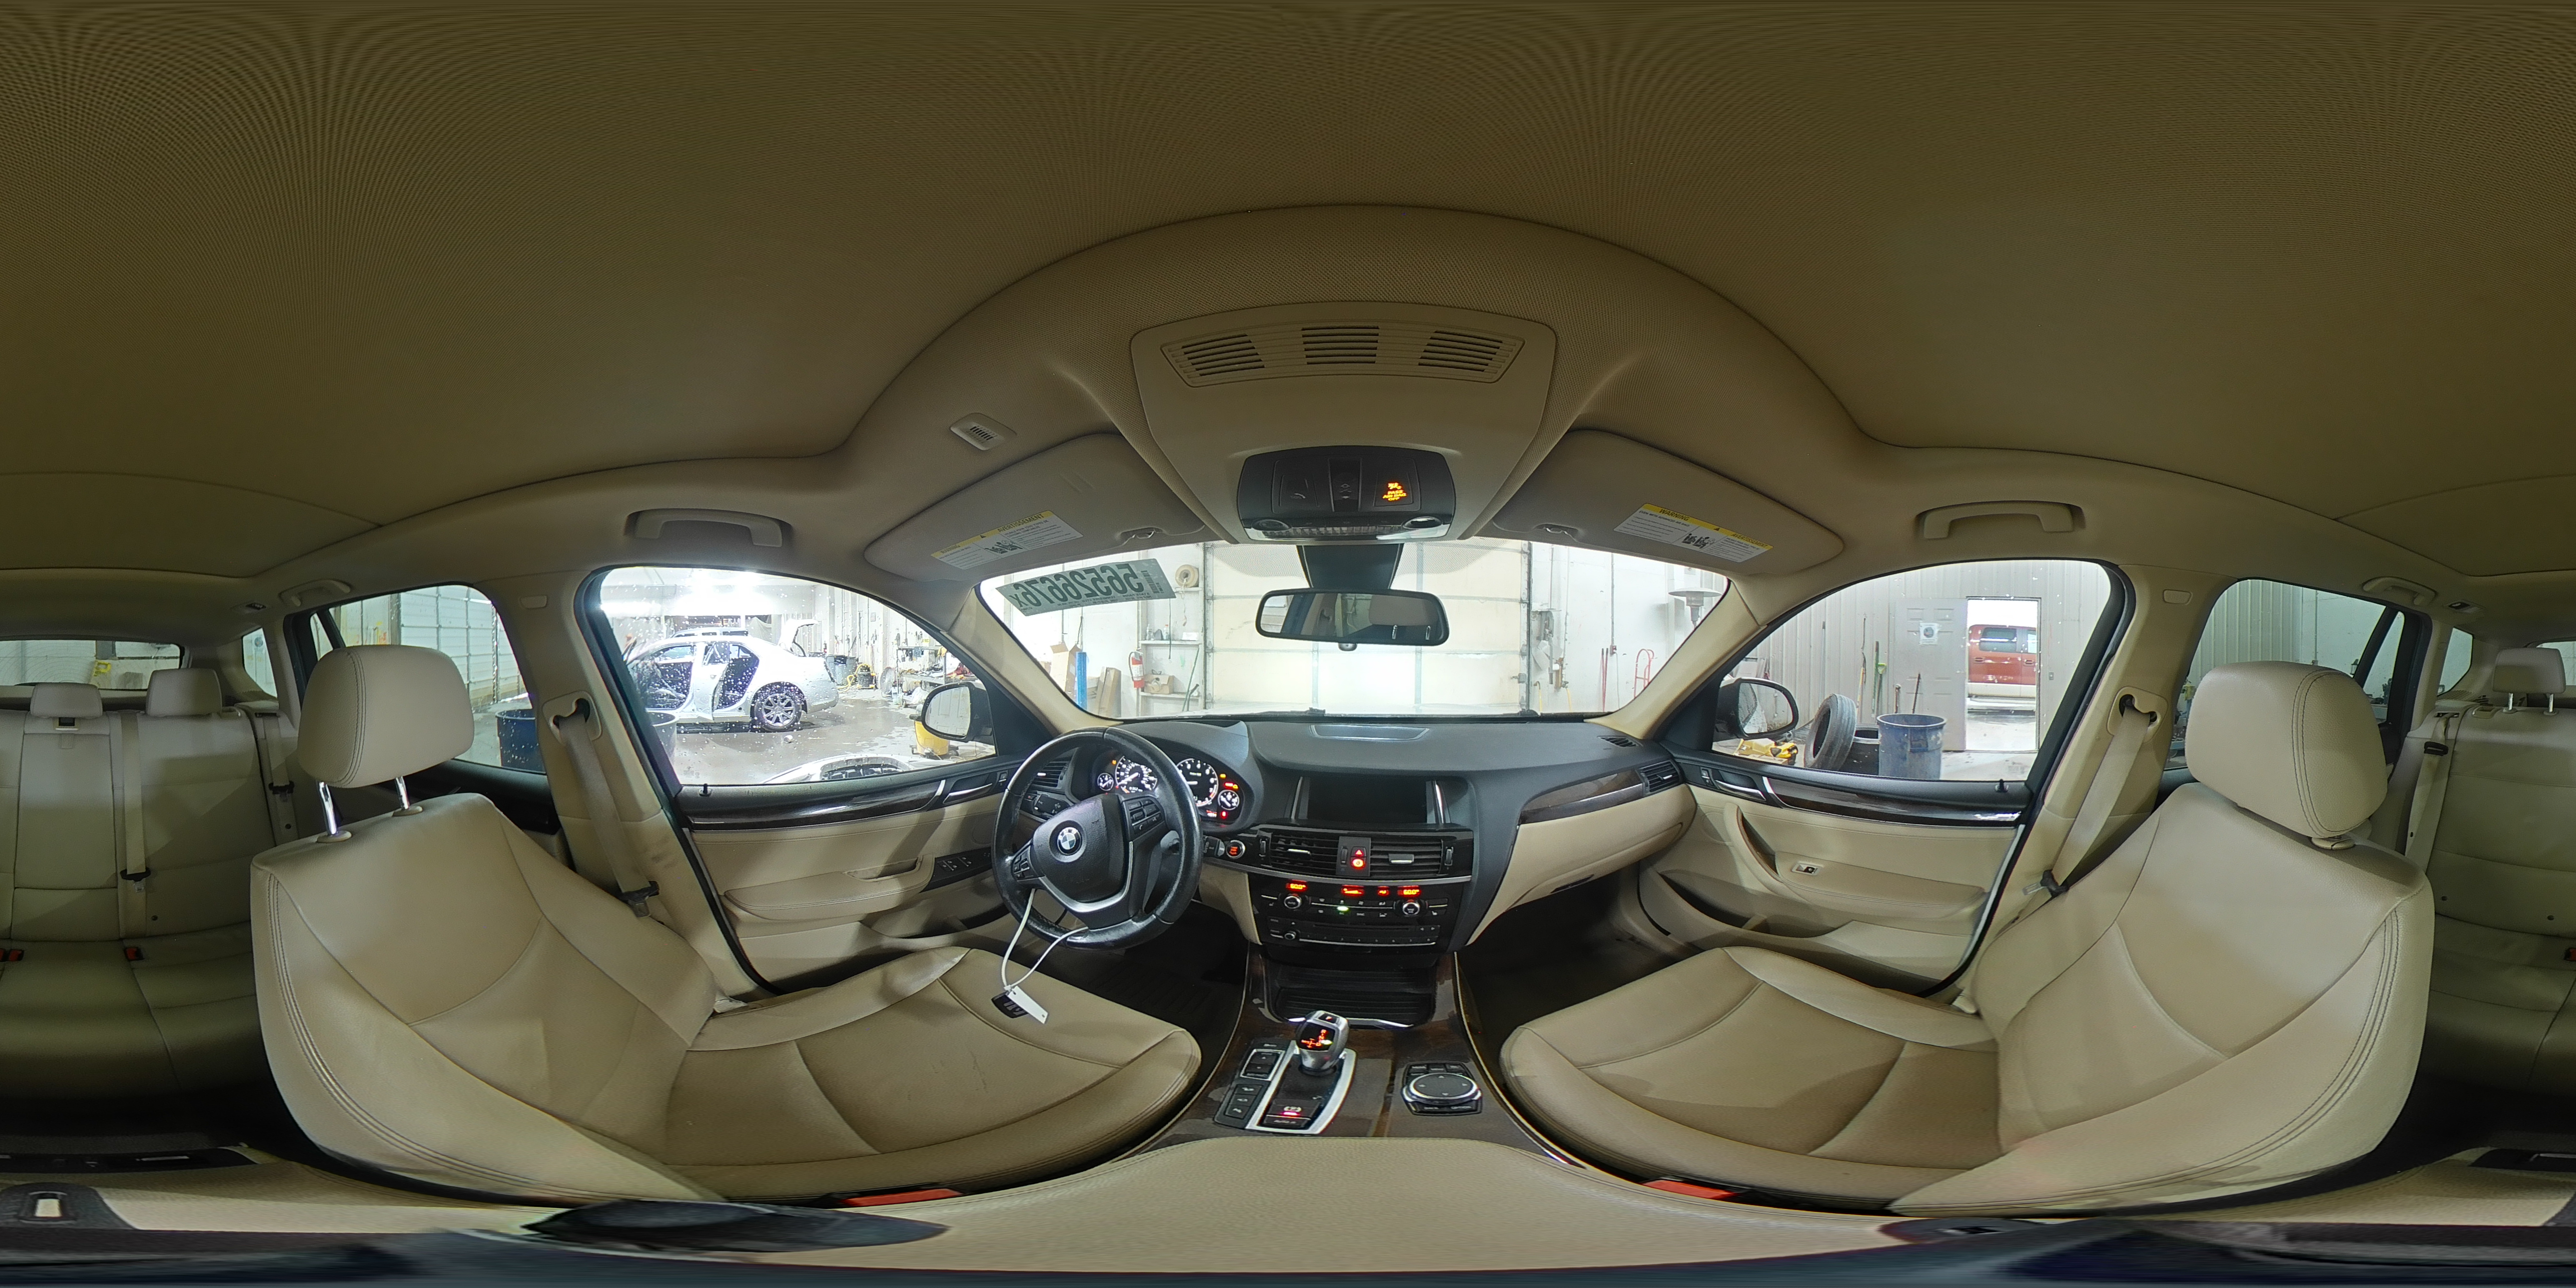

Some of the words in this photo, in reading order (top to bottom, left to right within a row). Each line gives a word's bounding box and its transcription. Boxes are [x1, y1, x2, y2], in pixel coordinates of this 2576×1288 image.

[1659, 508, 1690, 521] WARNING
[997, 513, 1044, 533] AVERTISSEMENT
[1731, 533, 1769, 548] AVERTISSEMENT
